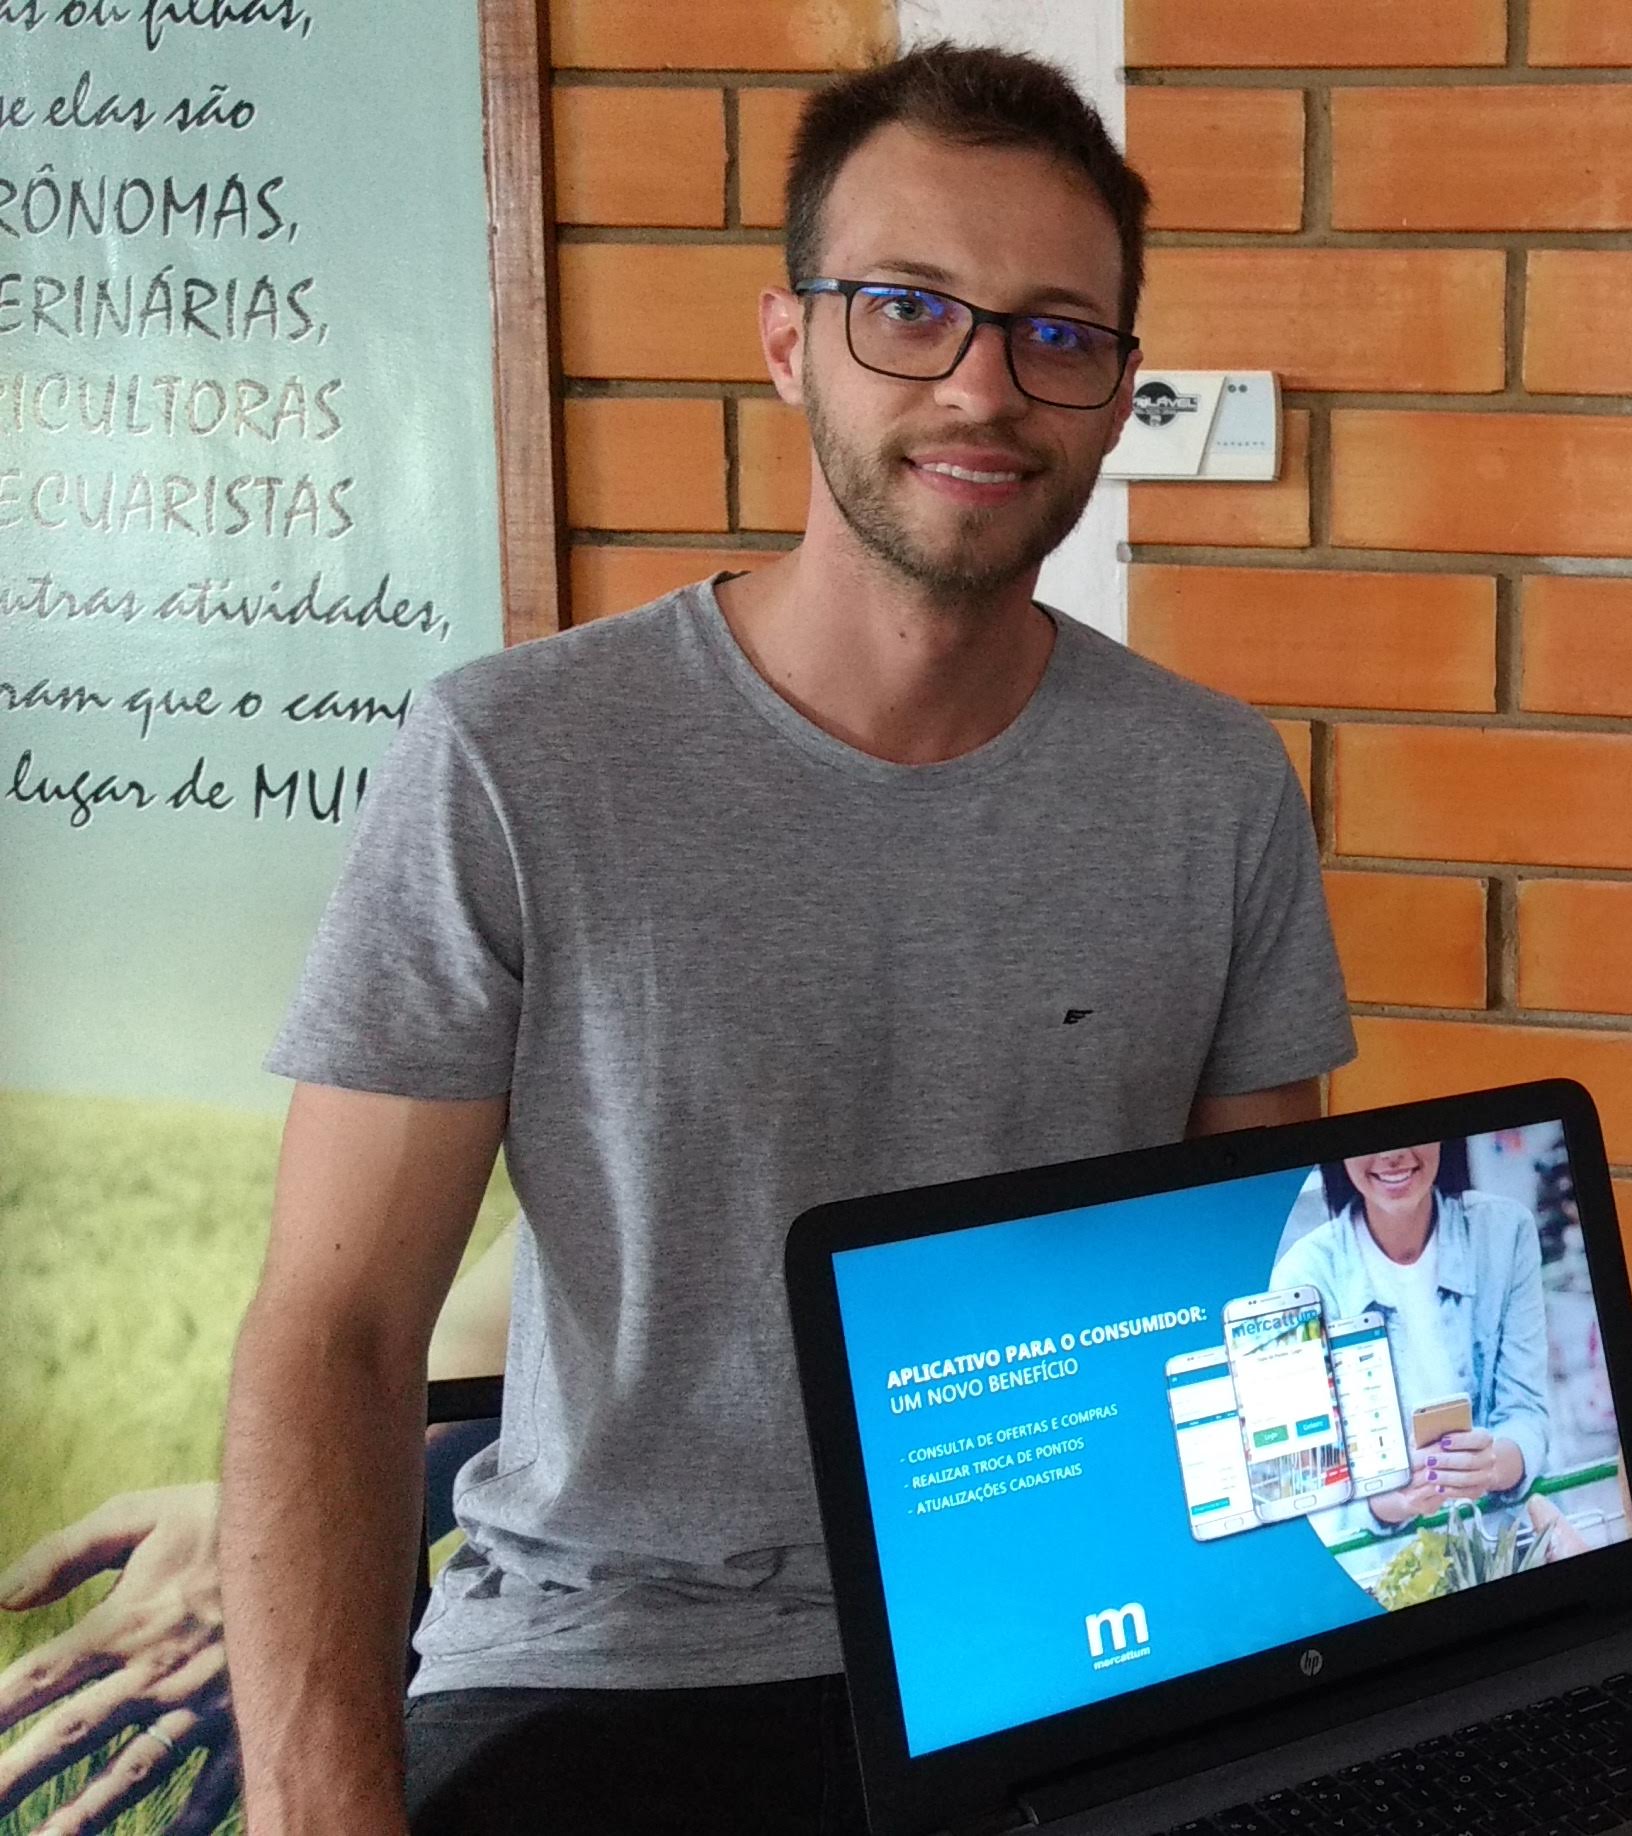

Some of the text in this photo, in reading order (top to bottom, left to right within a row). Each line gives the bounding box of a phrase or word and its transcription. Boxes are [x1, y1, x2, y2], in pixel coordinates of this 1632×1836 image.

[55, 0, 132, 28] ou
[0, 70, 256, 132] e elas são
[0, 264, 328, 345] ERINÁRIAS,
[0, 372, 344, 442] ICULTORAS
[0, 468, 355, 539] ECUARISTAS
[153, 571, 451, 642] atividades,
[122, 687, 222, 739] que
[229, 691, 263, 719] o
[5, 750, 157, 828] lugar
[165, 756, 235, 810] de
[887, 1305, 1208, 1389] APLICATIVO PARA O CONSUMIDOR:
[1231, 1309, 1318, 1338] mercattum
[890, 1357, 1079, 1414] UM NOVO BENEFÍCIO
[908, 1438, 975, 1464] CONSULTA
[976, 1432, 993, 1448] DE
[996, 1420, 1049, 1443] OFERTAS
[1051, 1418, 1059, 1431] E
[1061, 1403, 1119, 1428] COMPRAS
[912, 1464, 971, 1489] REALIZAR
[972, 1454, 1015, 1475] TROCA
[1017, 1449, 1033, 1465] DE
[1035, 1436, 1085, 1460] PONTOS
[916, 1481, 1007, 1516] ATUALIZAÇÕES
[1009, 1462, 1084, 1492] CADASTRAIS
[1085, 1601, 1150, 1658] m
[1093, 1646, 1151, 1671] mercattum
[1301, 1649, 1324, 1677] hp
